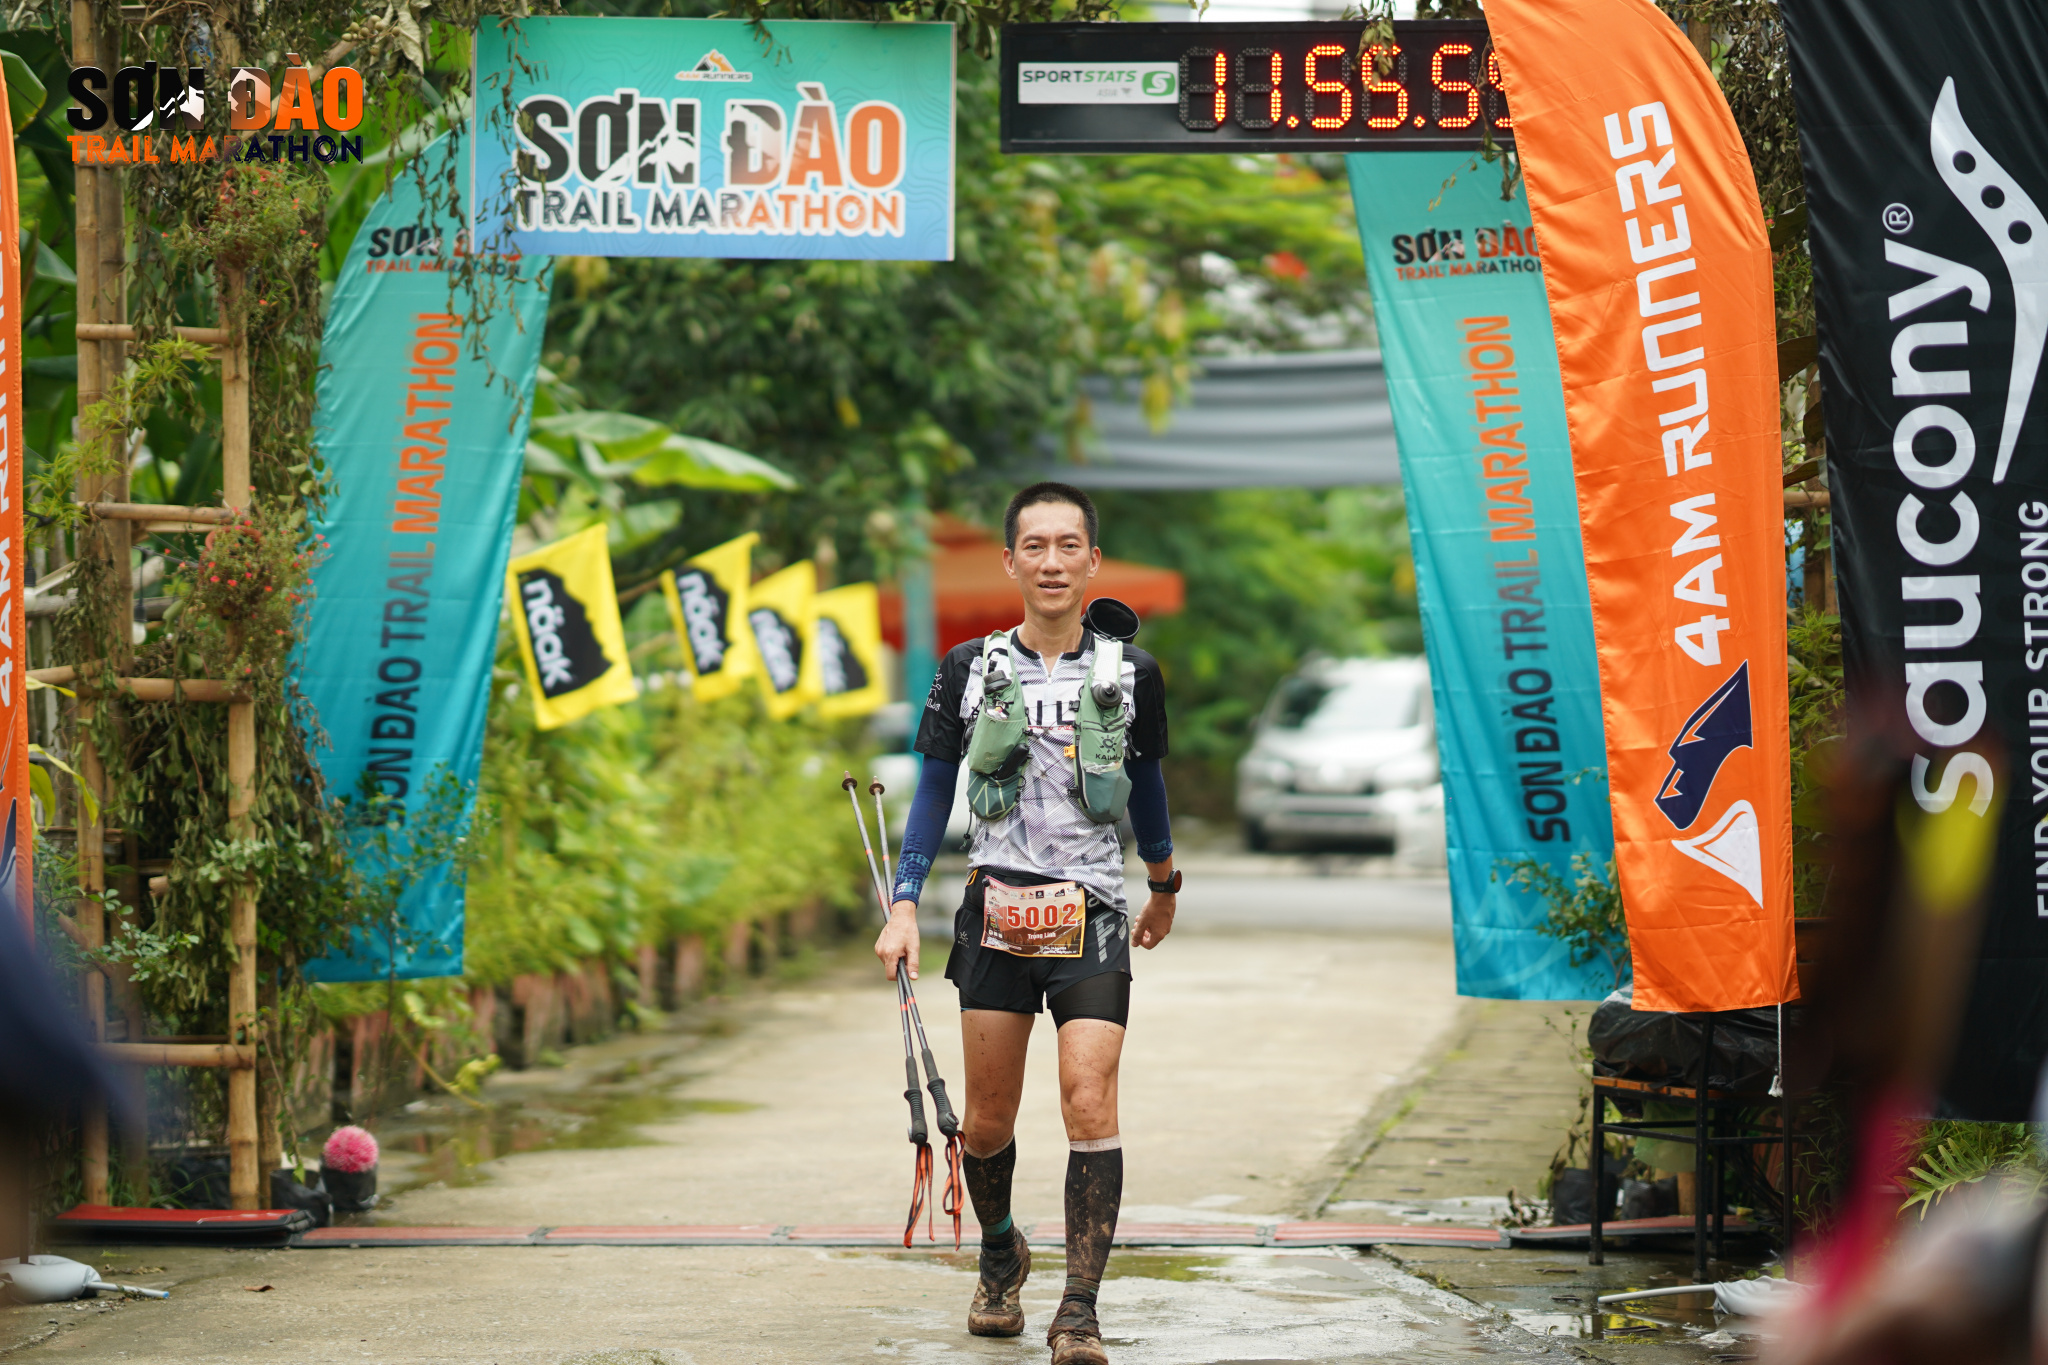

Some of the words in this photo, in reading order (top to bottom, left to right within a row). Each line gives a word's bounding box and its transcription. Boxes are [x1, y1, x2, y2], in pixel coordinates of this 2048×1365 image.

[1022, 70, 1137, 83] SPORTSTATS
[517, 91, 698, 185] SƠN
[726, 86, 902, 188] ĐÀO
[517, 189, 637, 228] TRAIL
[651, 192, 900, 232] MARATHON
[366, 259, 413, 273] TRAIL
[1395, 265, 1445, 281] TRAIL
[1603, 100, 1714, 478] RUNNERS
[391, 312, 464, 534] MARATHON
[1462, 315, 1537, 542] MARATHON
[380, 541, 436, 649] TRAIL
[1494, 549, 1548, 661] TRAIL
[1669, 492, 1729, 667] 4AM
[2018, 501, 2048, 672] STRONG
[1006, 902, 1078, 928] 5002
